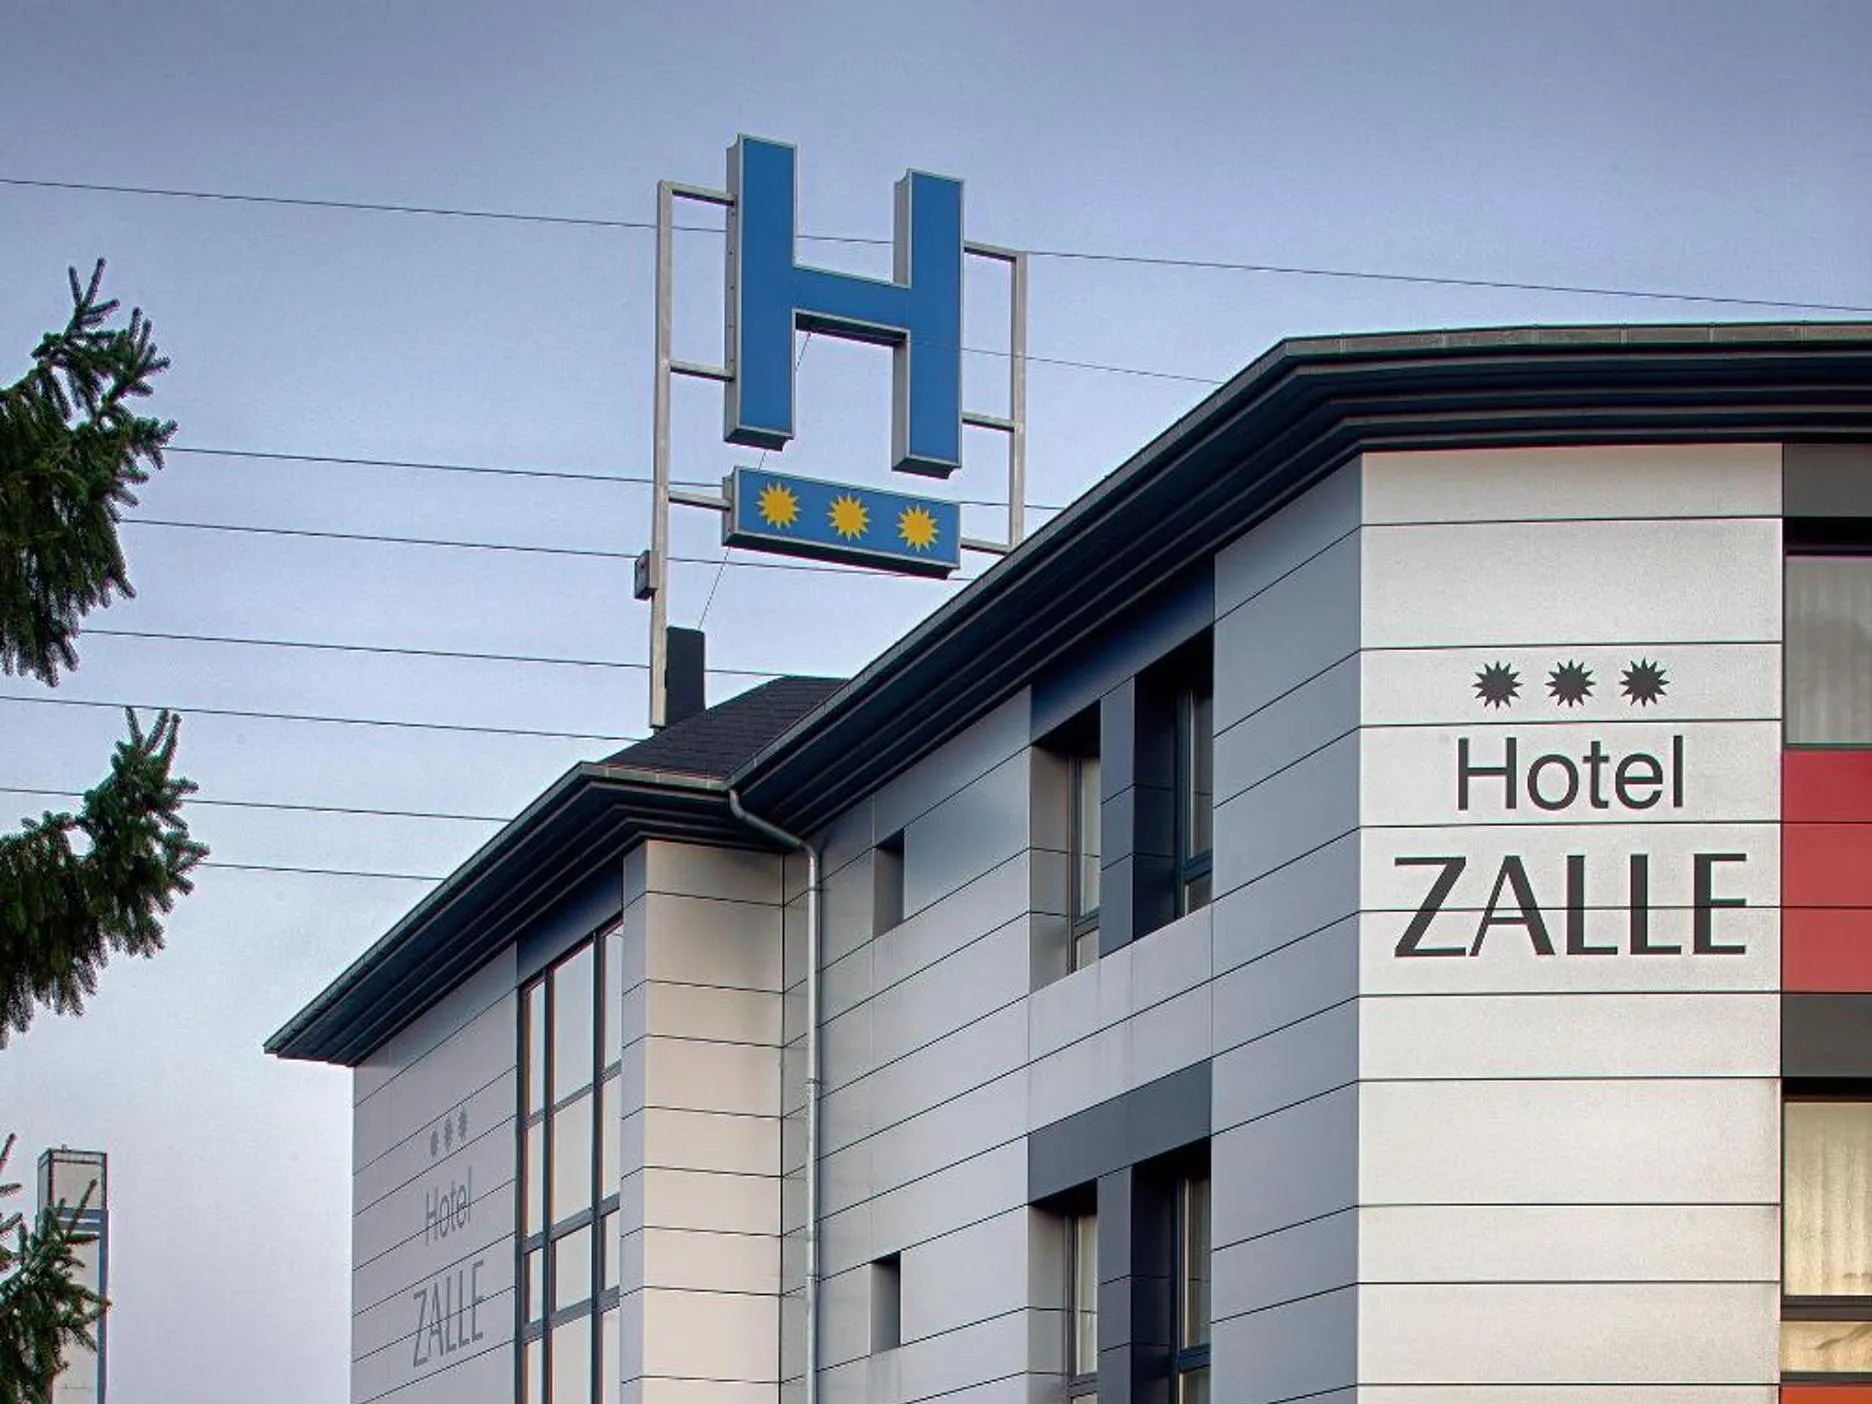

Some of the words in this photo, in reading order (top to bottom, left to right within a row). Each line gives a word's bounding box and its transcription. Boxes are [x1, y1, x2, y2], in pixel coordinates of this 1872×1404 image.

[724, 133, 964, 478] H
[1457, 735, 1684, 811] Hotel
[1394, 853, 1747, 957] ZALLE
[424, 1165, 473, 1246] Hotel
[413, 1259, 485, 1368] ZALLE
